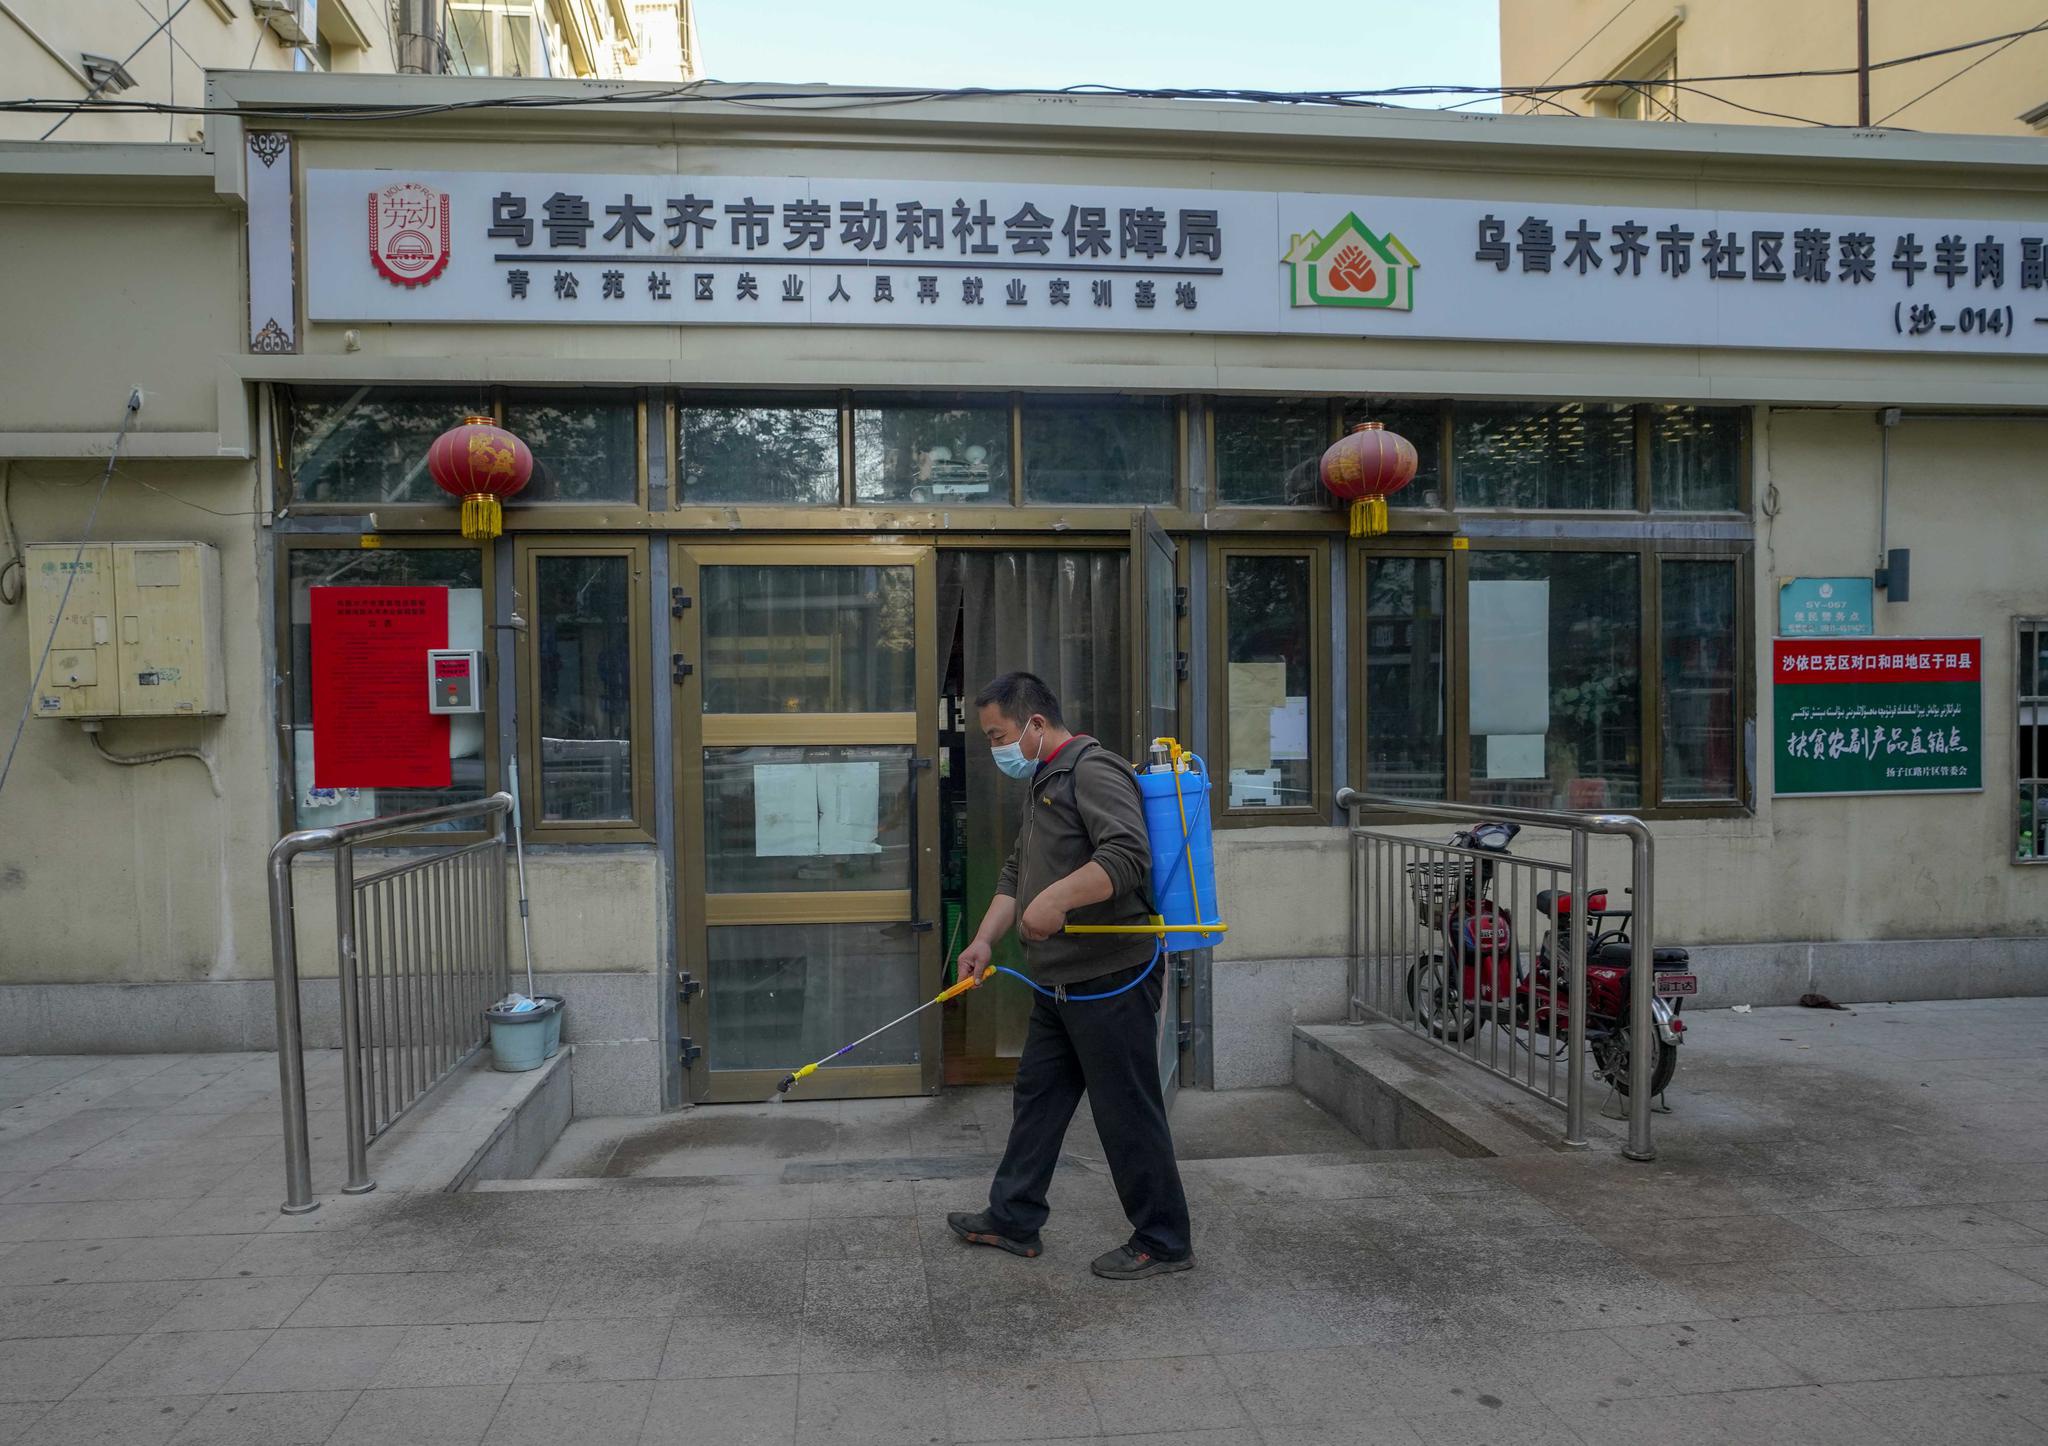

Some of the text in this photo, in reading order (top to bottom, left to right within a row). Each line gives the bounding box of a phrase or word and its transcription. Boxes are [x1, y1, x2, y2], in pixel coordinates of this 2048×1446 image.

[382, 198, 437, 230] 劳动
[487, 191, 1223, 261] 乌鲁木齐市劳动和社会保障局
[507, 268, 1198, 310] 青松苑社区失业人员再就业实训基地
[1782, 653, 1972, 671] 沙依巴克区对口和田地区于田县
[1787, 725, 1967, 760] 扶贫农副产品直销点
